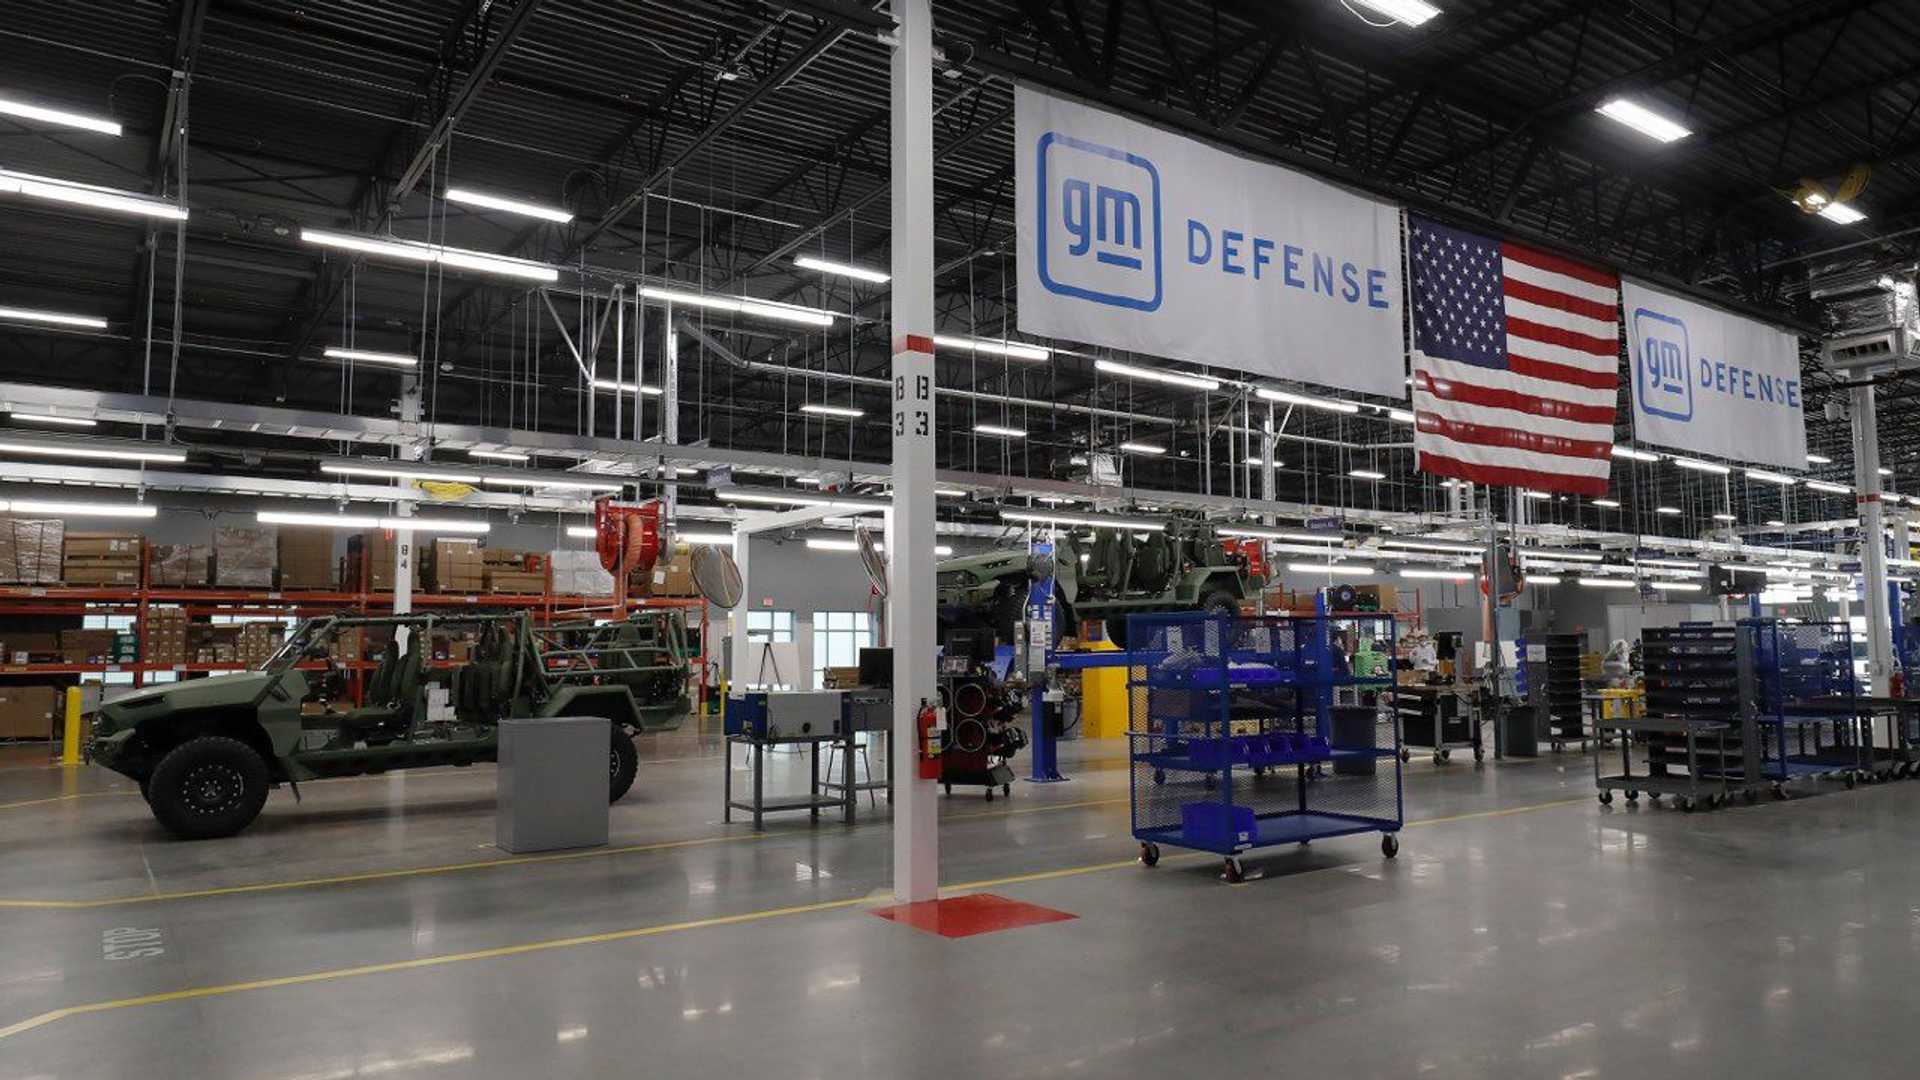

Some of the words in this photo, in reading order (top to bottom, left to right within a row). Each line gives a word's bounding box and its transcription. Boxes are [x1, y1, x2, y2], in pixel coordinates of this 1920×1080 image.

[1062, 178, 1142, 257] gm
[1187, 218, 1390, 309] DEFENSE
[1646, 337, 1682, 388] gm
[1700, 358, 1799, 408] DEFENSE
[102, 927, 165, 960] STOP
